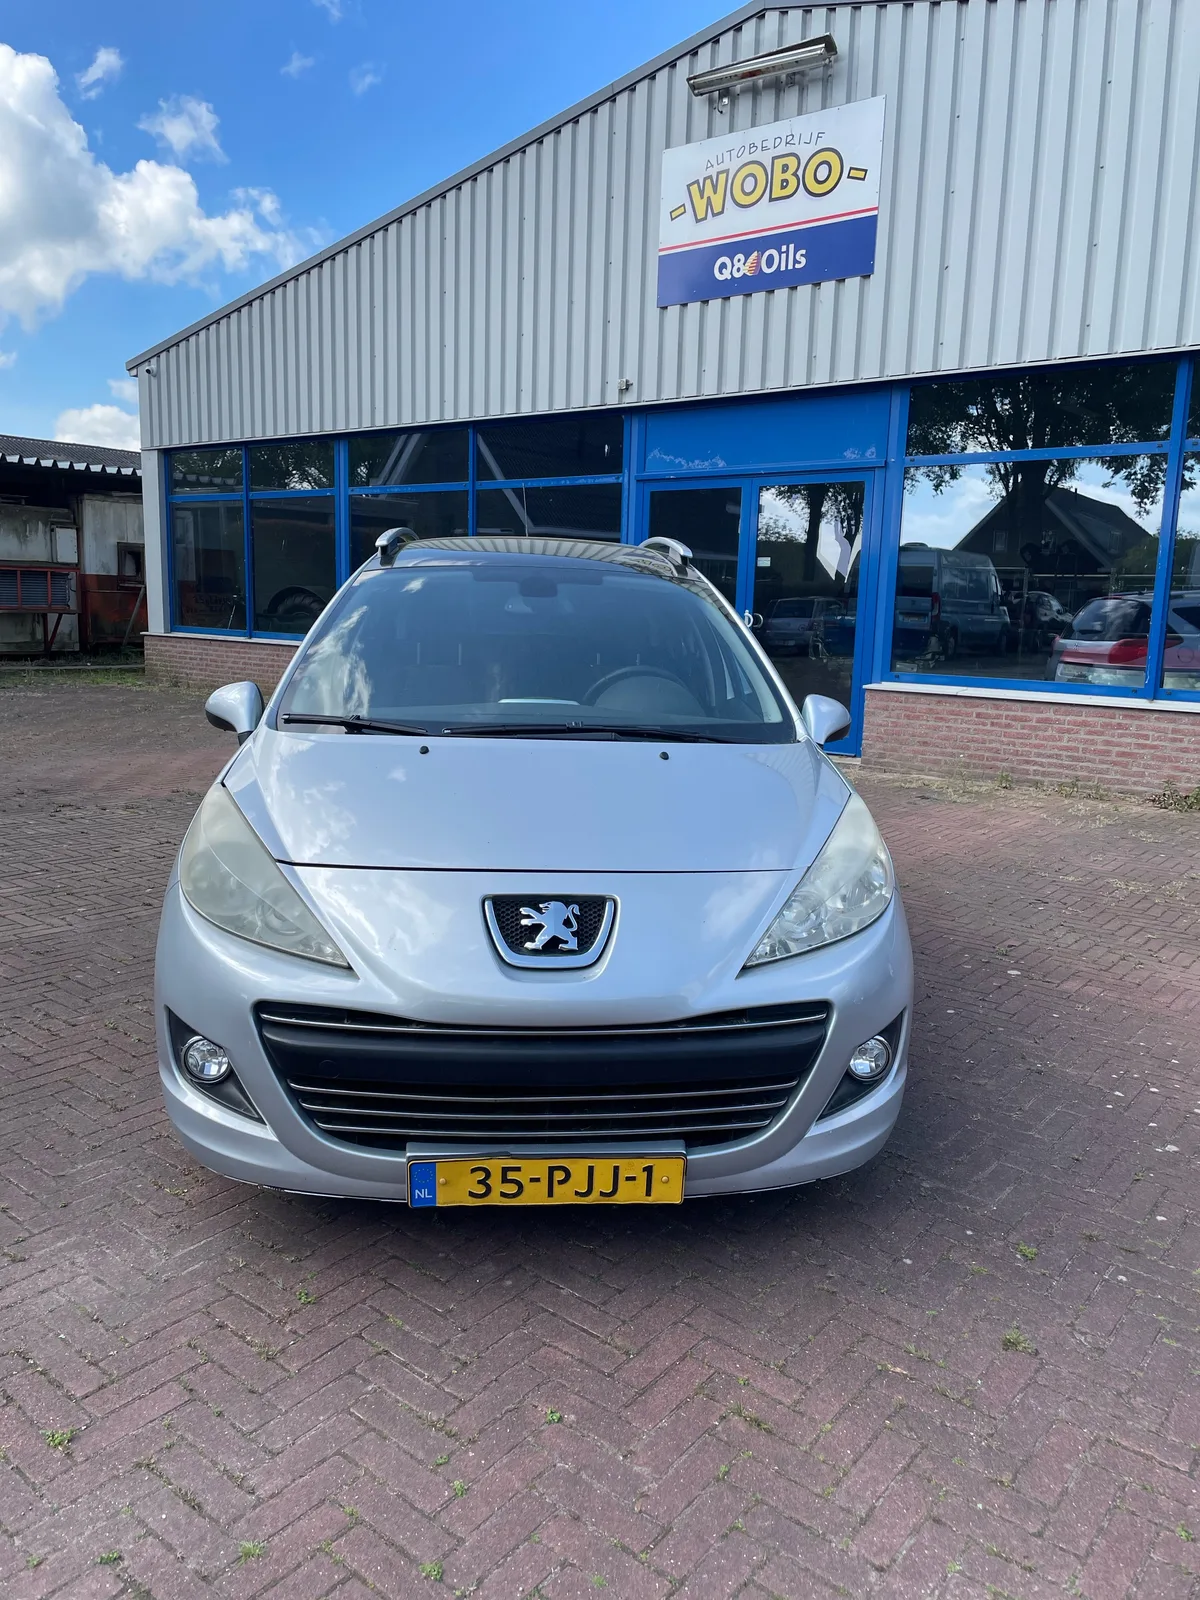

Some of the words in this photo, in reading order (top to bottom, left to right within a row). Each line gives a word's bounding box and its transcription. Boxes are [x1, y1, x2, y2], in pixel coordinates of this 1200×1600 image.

[705, 132, 825, 171] AUTOBEDRIJF
[761, 243, 807, 274] Oils
[414, 1189, 433, 1199] NL
[467, 1164, 654, 1199] 35-PJJ-1
